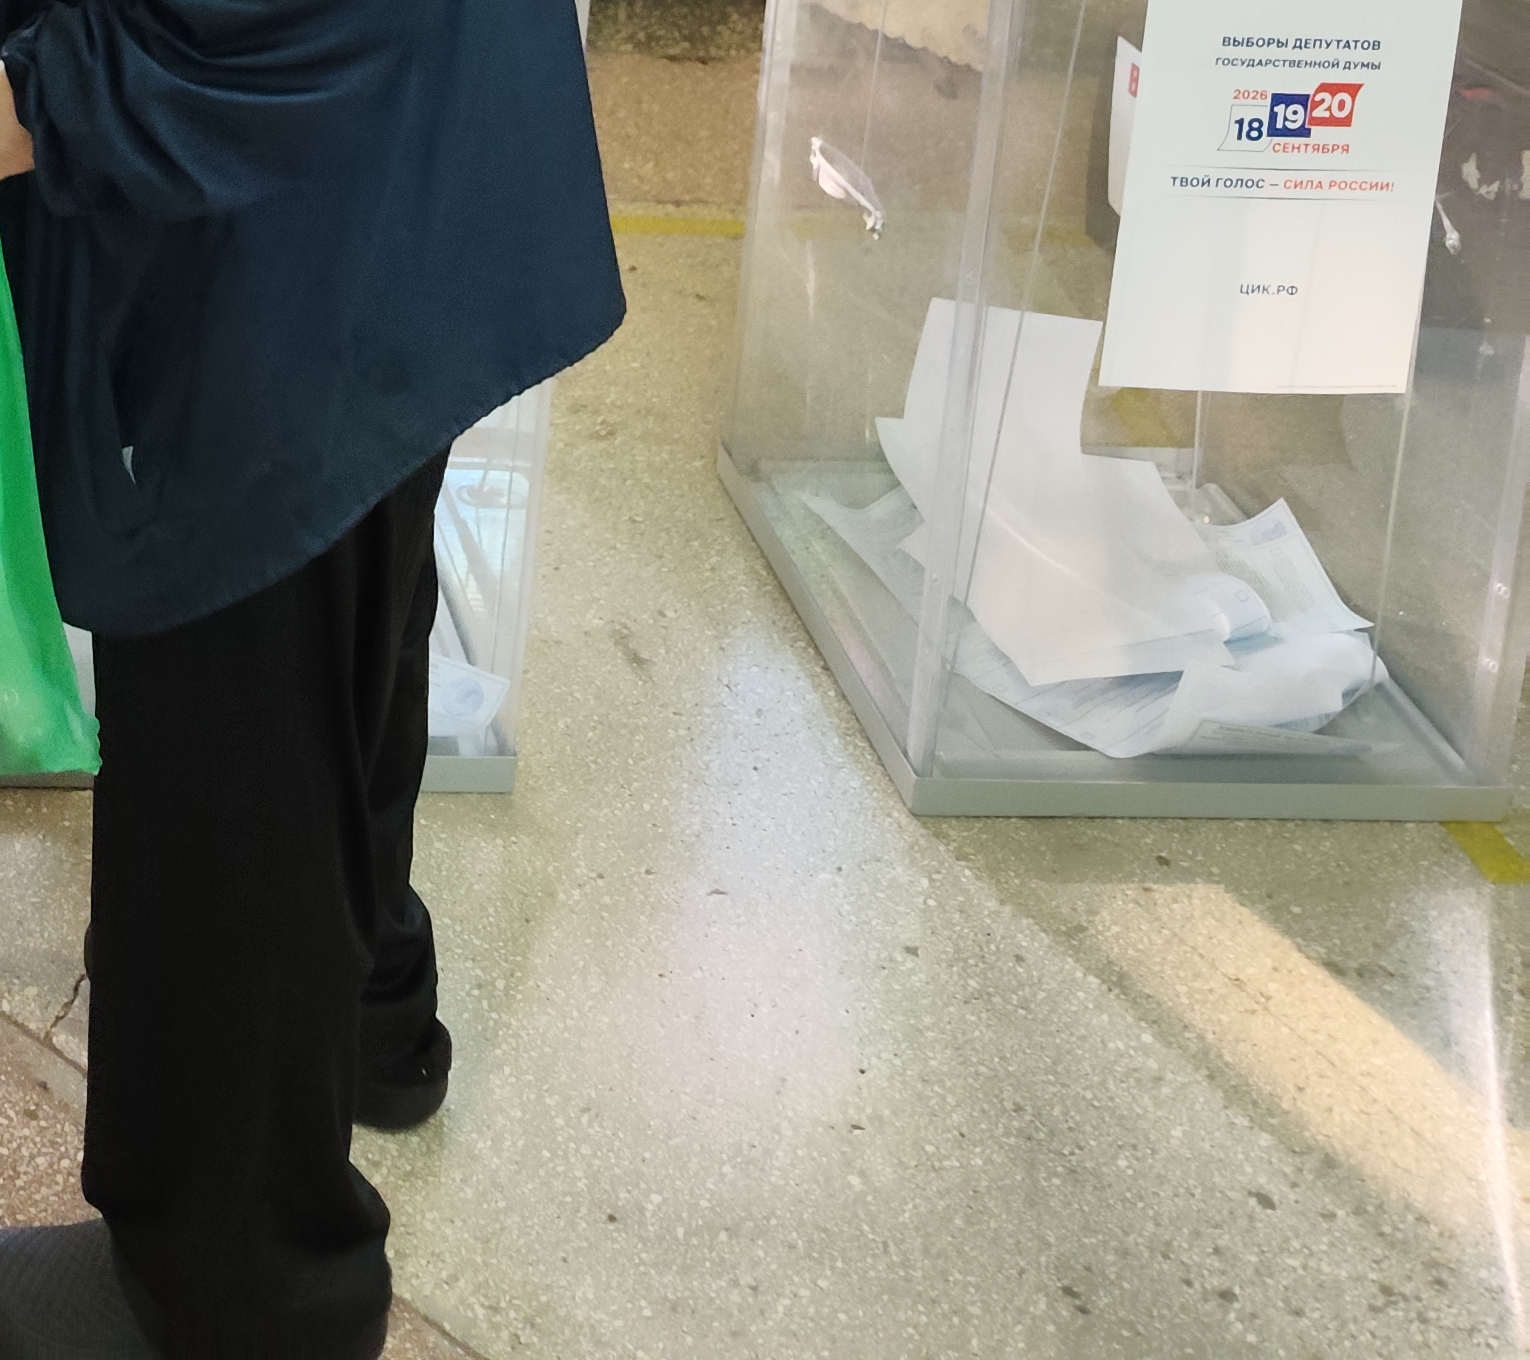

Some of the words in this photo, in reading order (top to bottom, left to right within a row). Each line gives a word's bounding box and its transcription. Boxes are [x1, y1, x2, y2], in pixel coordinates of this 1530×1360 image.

[1221, 36, 1289, 49] ВЫБОРЫ
[1291, 37, 1382, 51] ДЕПУТАТОВ
[1214, 56, 1340, 69] ГОСУДАРСТВЕННОЙ
[1342, 60, 1382, 71] ДУМЫ
[1232, 88, 1268, 100] 2026
[1234, 117, 1264, 141] 18
[1273, 103, 1305, 130] 19
[1311, 92, 1353, 119] 20
[1272, 142, 1350, 155] СЕНТЯБРЯ
[1170, 174, 1211, 188] ТВОЙ
[1215, 177, 1266, 190] ГОЛОС
[1283, 178, 1324, 191] СИЛА
[1328, 180, 1395, 193] РОССИИ!
[1239, 283, 1299, 296] ЦИК.РФ
